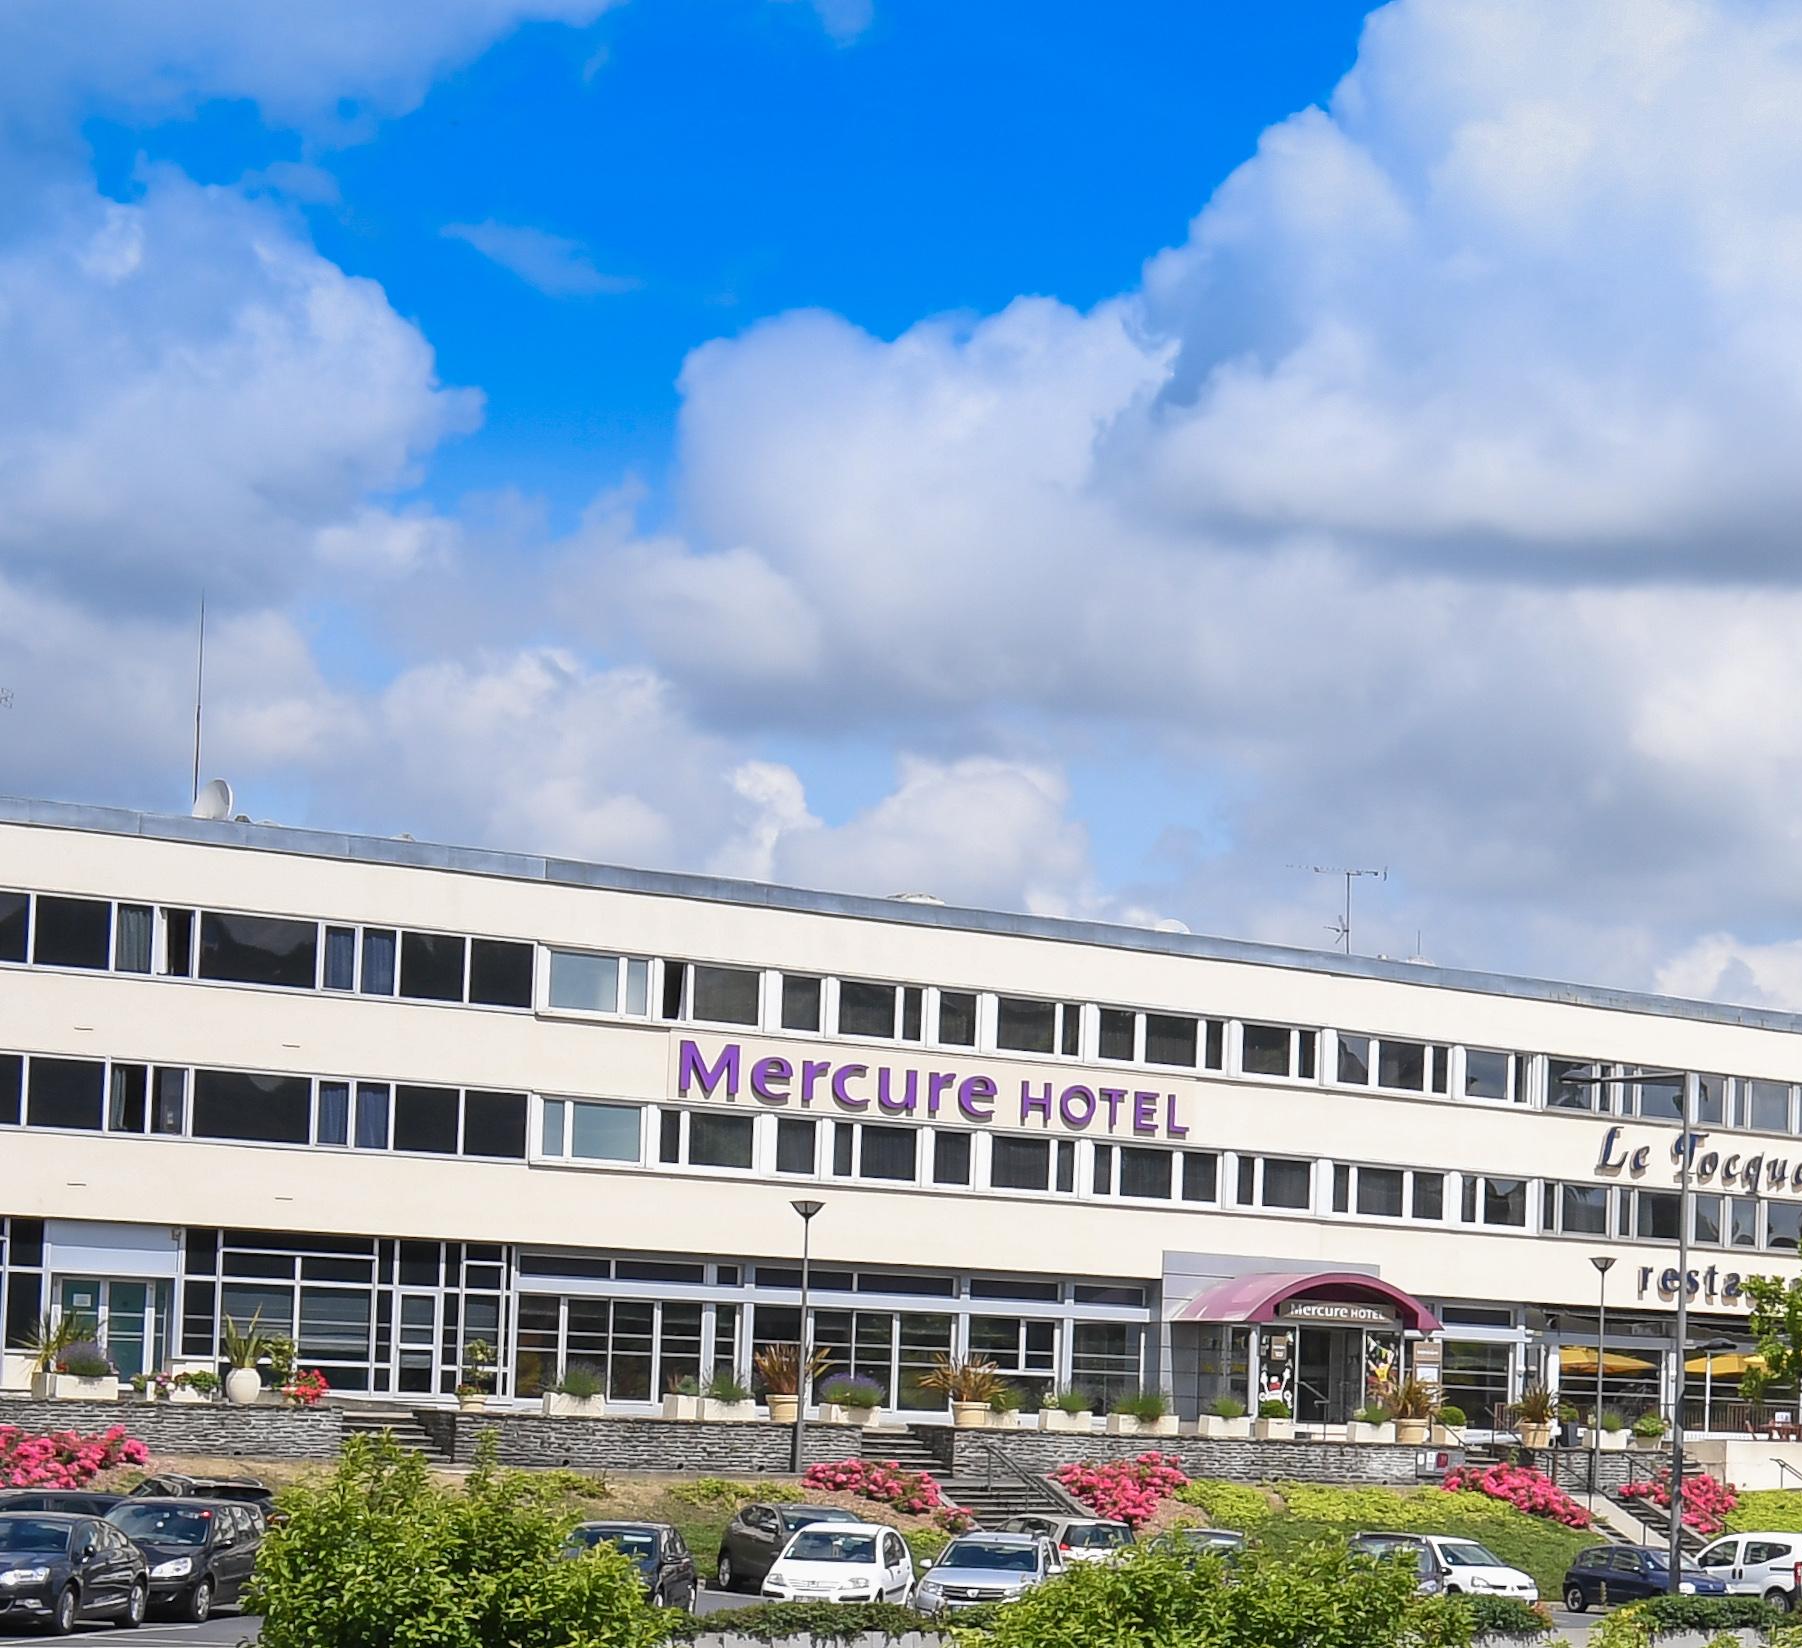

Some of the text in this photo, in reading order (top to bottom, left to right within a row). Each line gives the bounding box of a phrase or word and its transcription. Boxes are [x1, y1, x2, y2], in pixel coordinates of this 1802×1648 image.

[680, 1040, 1190, 1134] Mercure HOTEL
[1599, 1126, 1650, 1172] Le
[1290, 1303, 1385, 1320] Mercure HOTEL
